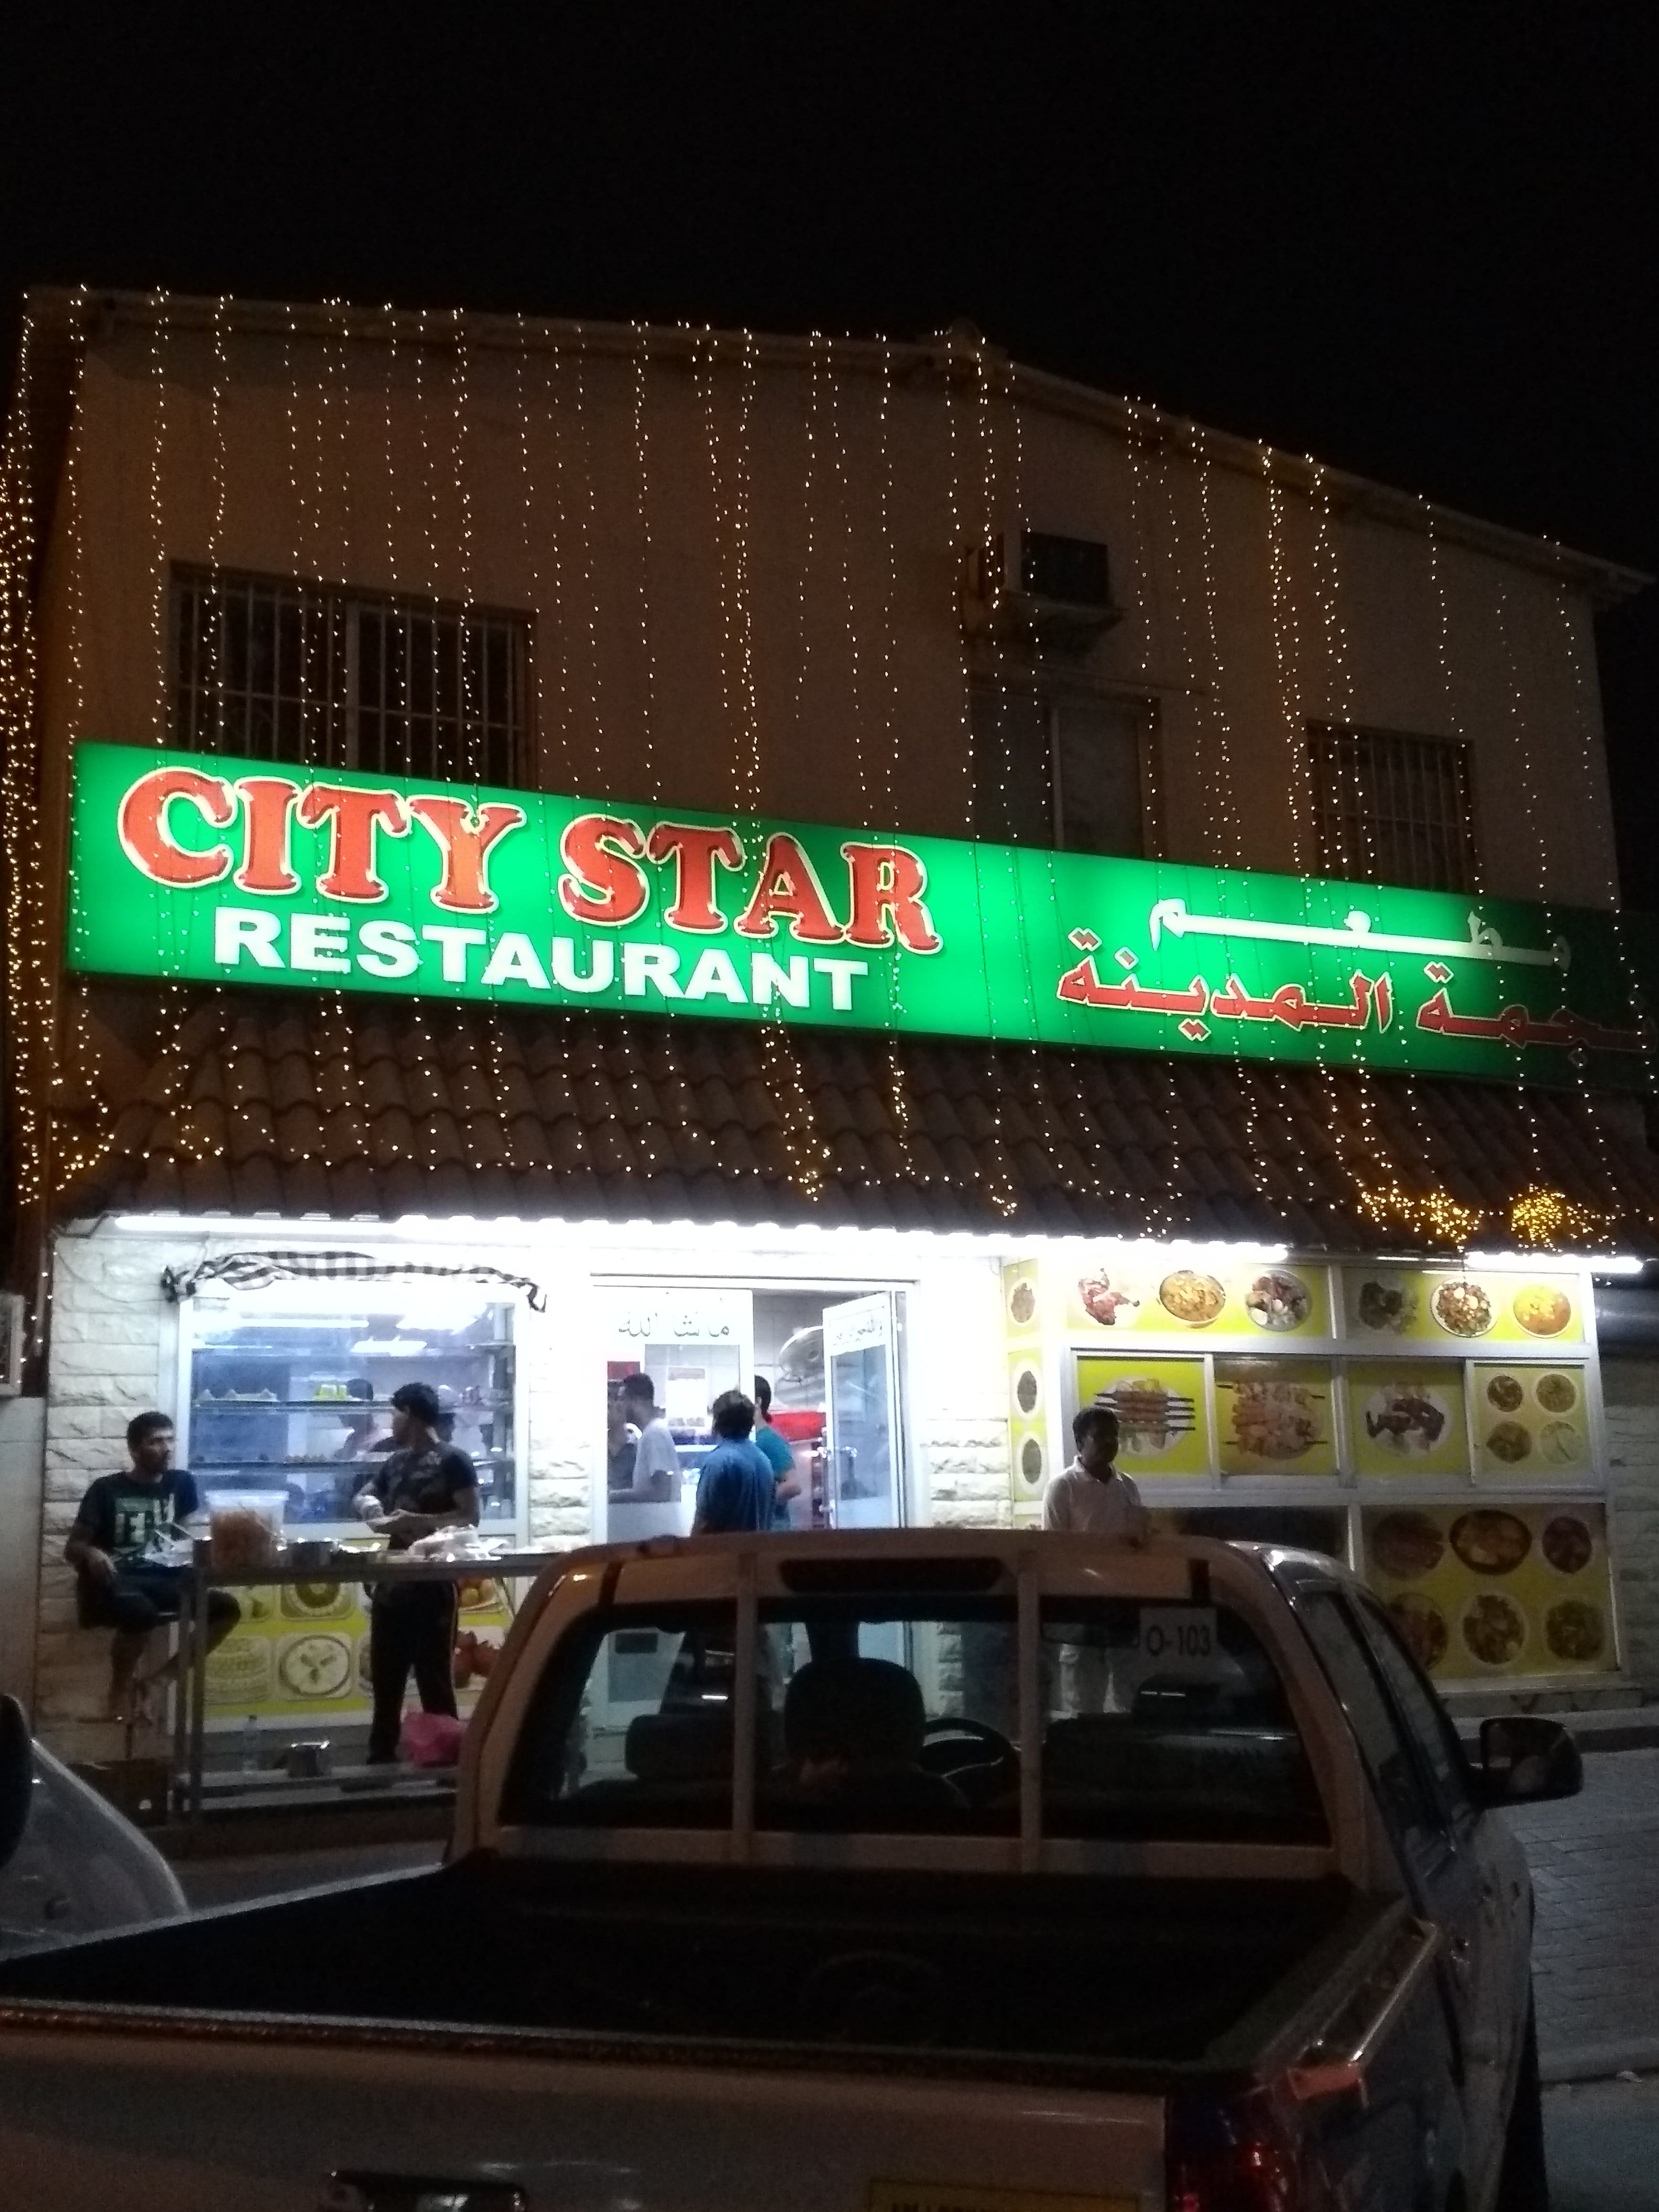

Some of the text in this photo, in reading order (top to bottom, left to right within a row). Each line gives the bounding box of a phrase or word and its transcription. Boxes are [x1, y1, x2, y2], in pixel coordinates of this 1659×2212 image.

[117, 766, 944, 954] CITY STAR
[213, 905, 868, 1011] RESTAURANT
[1057, 927, 1393, 1041] المدينة
[1150, 898, 1571, 970] مطعم
